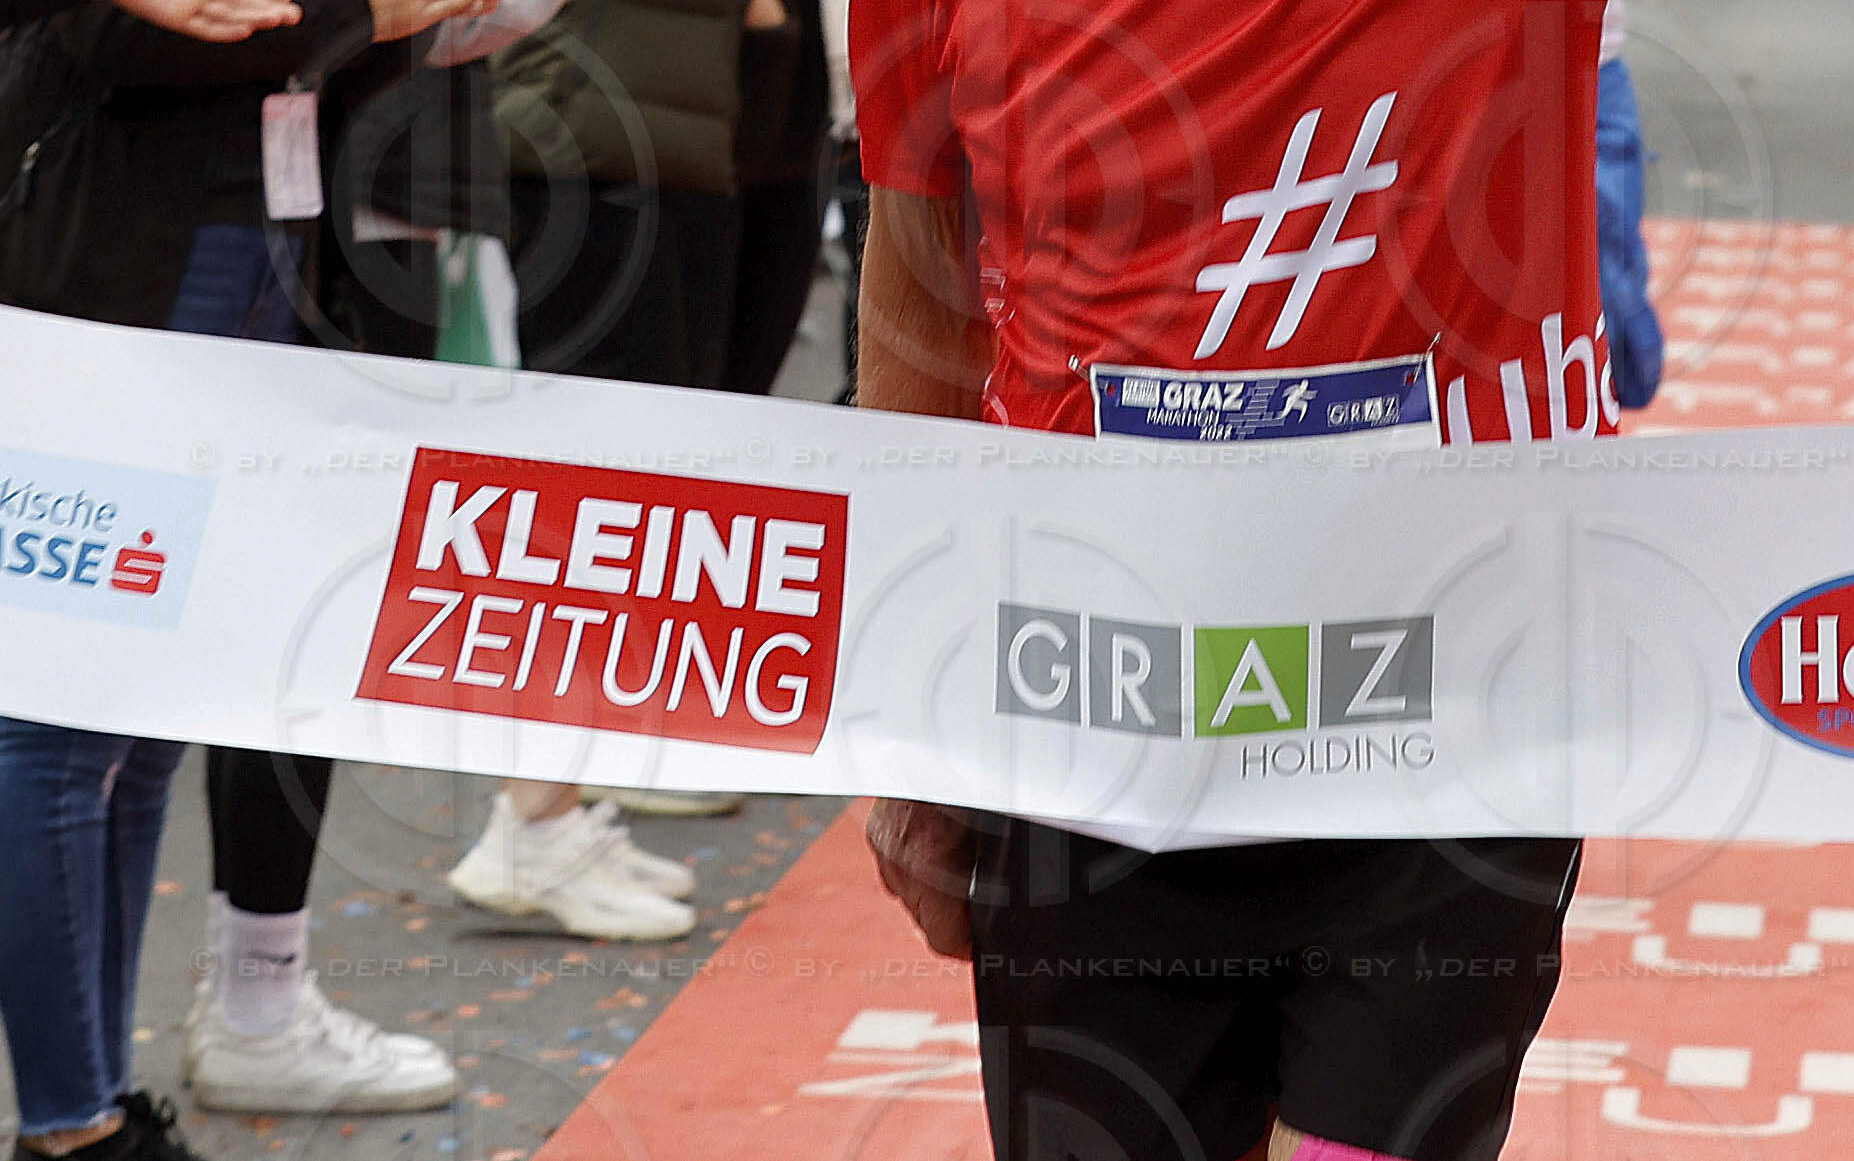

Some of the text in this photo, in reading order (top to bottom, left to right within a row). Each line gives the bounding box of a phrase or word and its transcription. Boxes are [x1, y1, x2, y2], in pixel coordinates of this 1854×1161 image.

[1163, 382, 1244, 411] GRAZ
[0, 527, 107, 586] SSE
[416, 479, 826, 617] KLEINE
[387, 586, 813, 727] ZEITUNG
[1008, 618, 1408, 728] GRAZ
[1240, 733, 1435, 779] HOLDING
